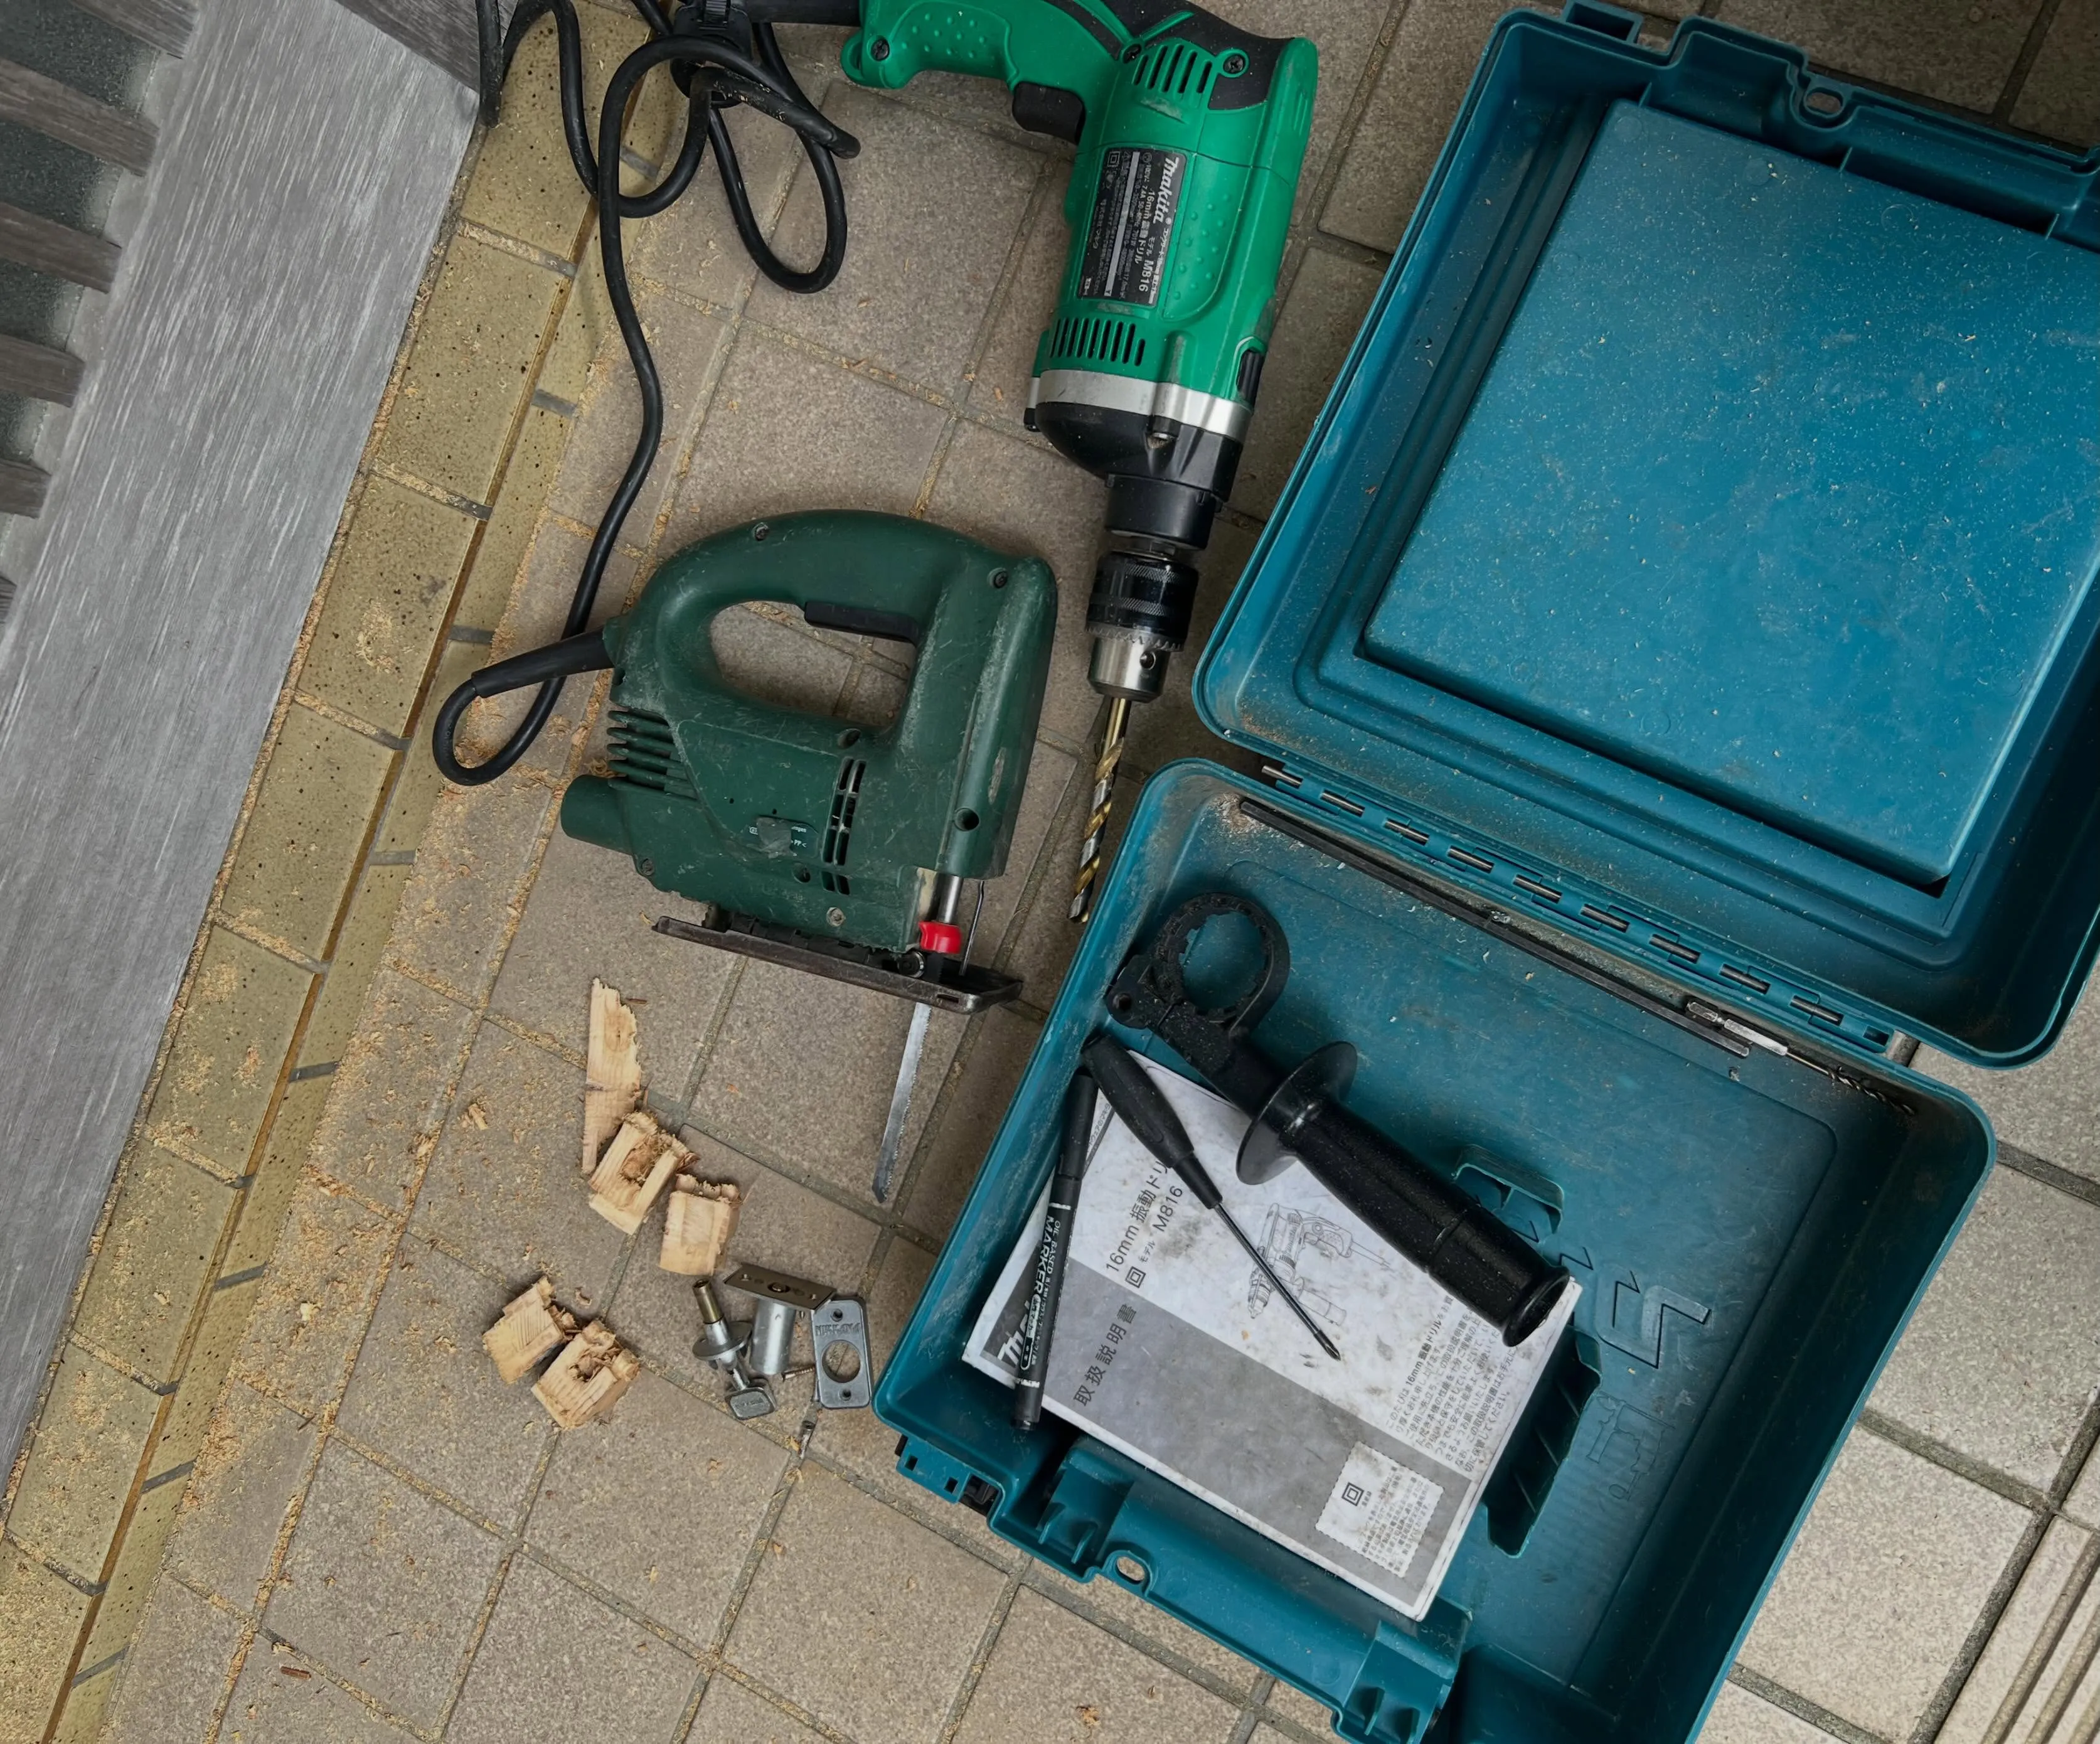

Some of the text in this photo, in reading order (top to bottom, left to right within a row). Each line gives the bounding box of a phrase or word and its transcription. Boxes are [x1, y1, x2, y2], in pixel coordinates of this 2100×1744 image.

[1142, 190, 1154, 219] 16mm
[1153, 155, 1179, 225] makita
[1138, 259, 1153, 292] M816
[1052, 1219, 1061, 1237] OIL
[1104, 1159, 1171, 1274] 16mm 振動ドリ
[1138, 1184, 1185, 1264] モデル M816
[1033, 1214, 1055, 1294] MARKER
[1071, 1300, 1139, 1408] 取扱説明書
[1404, 1359, 1423, 1386] 16mm
